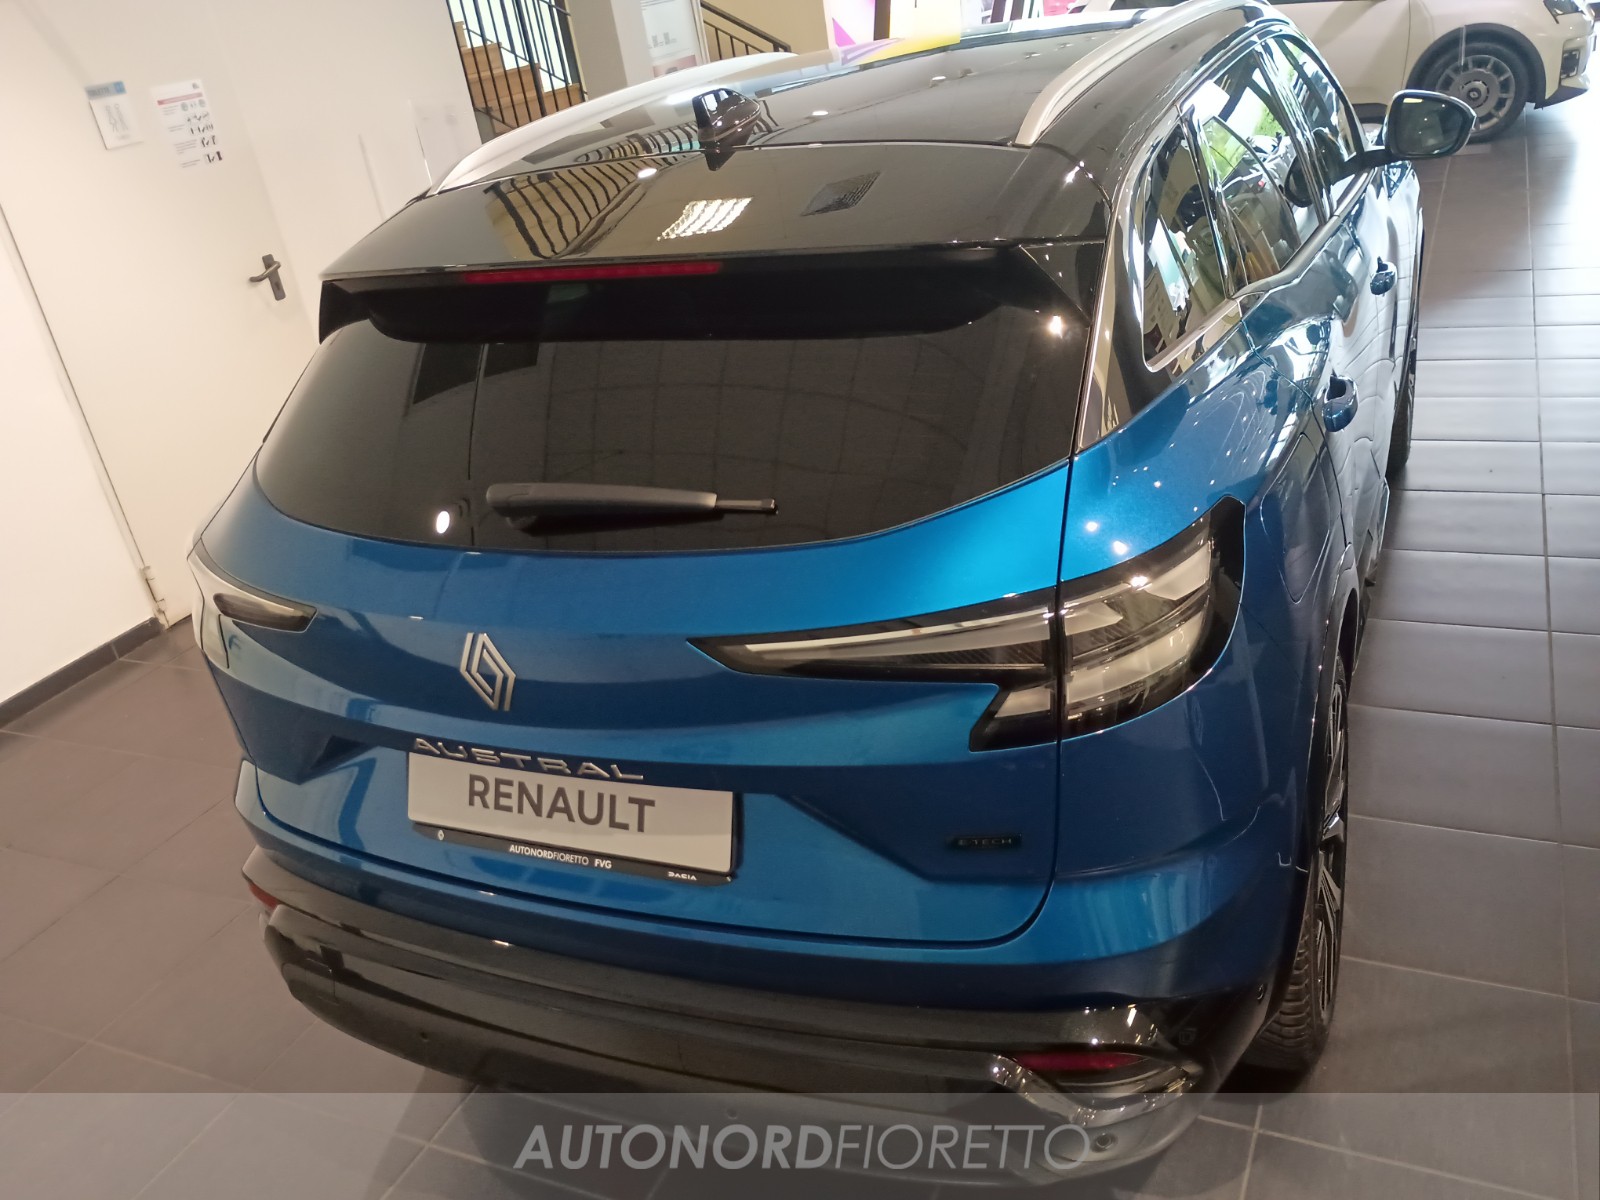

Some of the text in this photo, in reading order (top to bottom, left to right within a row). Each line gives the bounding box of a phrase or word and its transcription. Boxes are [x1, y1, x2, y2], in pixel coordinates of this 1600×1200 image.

[414, 738, 643, 780] AUSTRAL
[468, 774, 656, 833] RENAULT
[509, 844, 613, 870] AUTONORDFIORETTO FVG
[667, 871, 698, 882] DACIA
